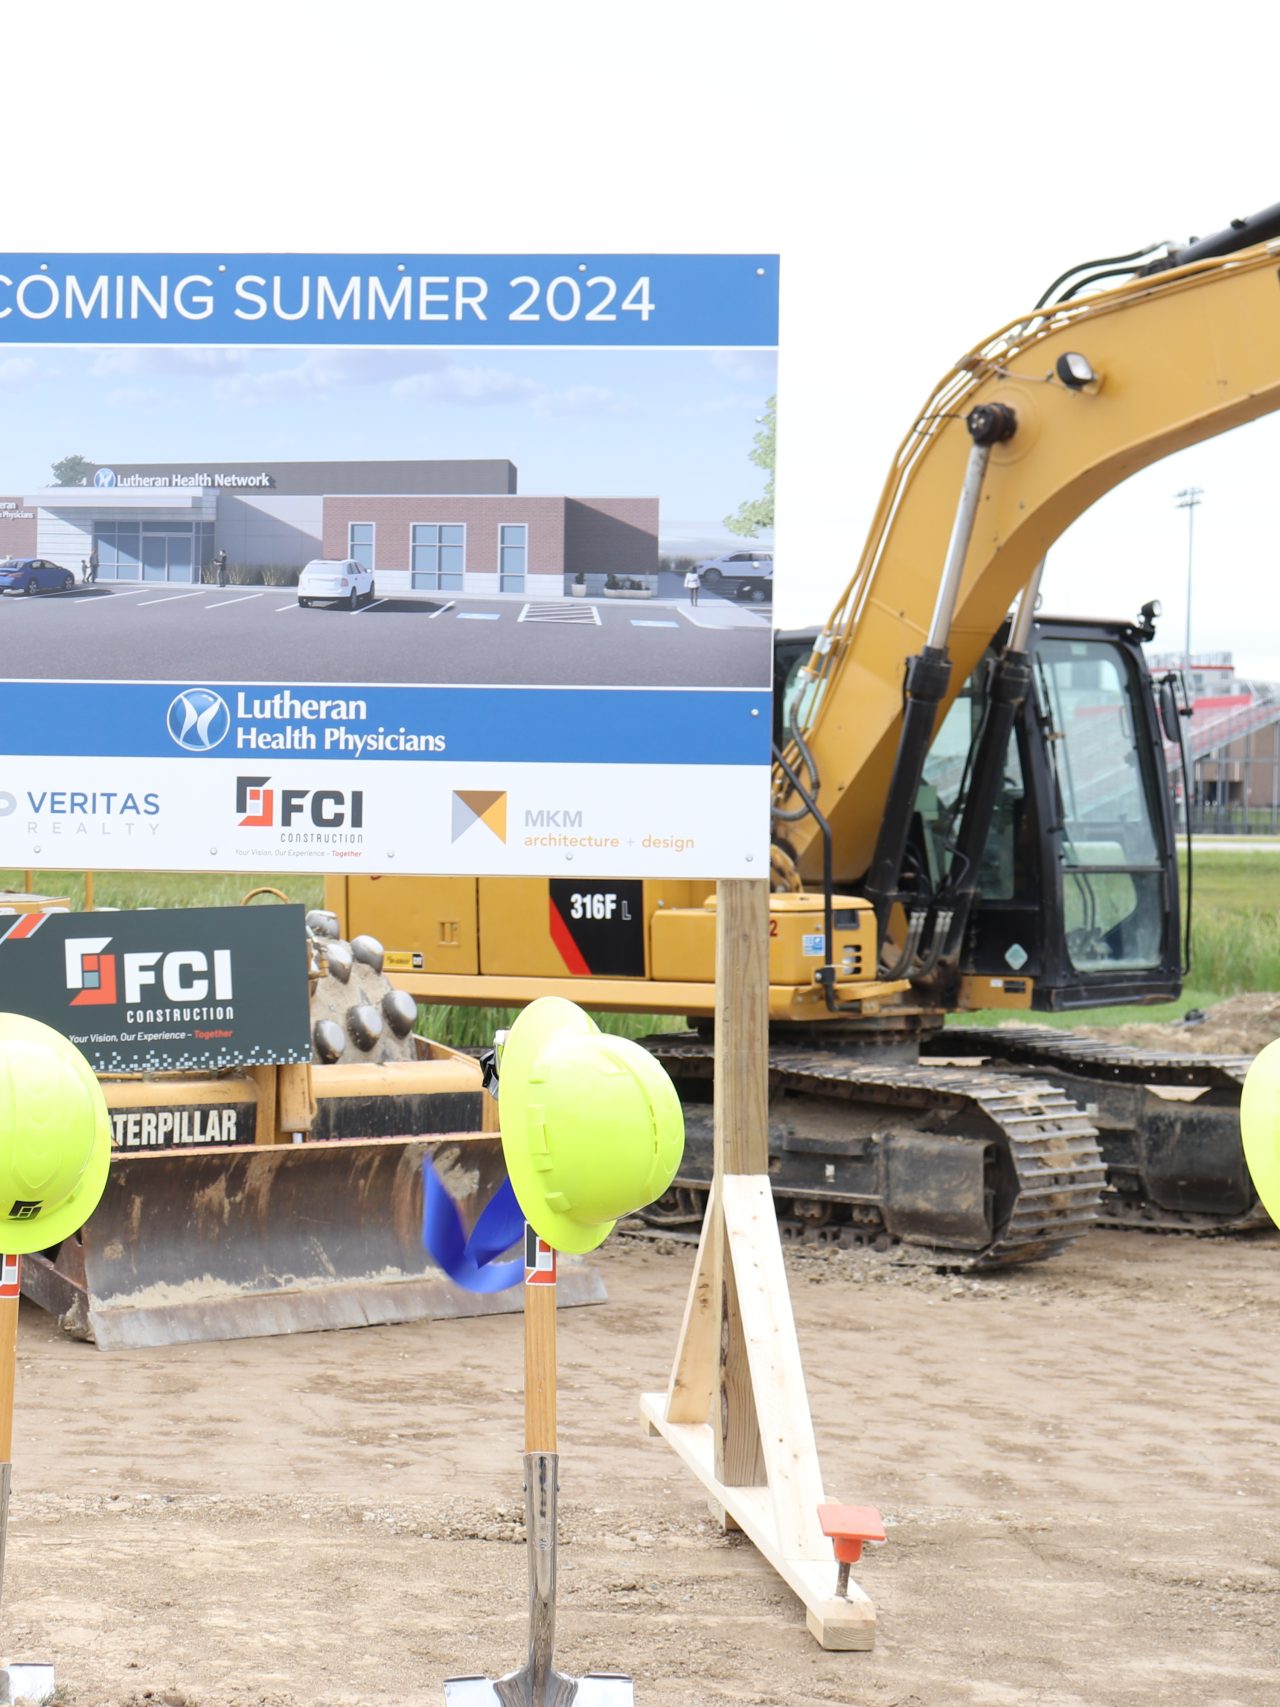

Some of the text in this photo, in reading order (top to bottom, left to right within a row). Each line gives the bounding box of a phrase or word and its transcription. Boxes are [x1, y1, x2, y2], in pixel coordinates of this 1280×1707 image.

[233, 275, 489, 321] SUMMER
[508, 276, 656, 321] 2024
[117, 473, 270, 487] Lutheran Health Network
[236, 690, 368, 720] Lutheran
[236, 726, 446, 758] Health Physicians
[27, 792, 160, 815] VERITAS
[281, 789, 363, 828] FCI
[27, 821, 160, 836] REALTY
[524, 810, 583, 828] MKM
[280, 833, 363, 843] CONSTRUCTION
[524, 833, 620, 848] architecture
[641, 834, 695, 852] design
[235, 849, 250, 857] Your
[274, 849, 287, 857] Our
[287, 850, 325, 858] Experience
[332, 850, 362, 858] Together
[570, 893, 632, 920] 316F L
[123, 949, 233, 1004] FCI
[126, 1006, 234, 1024] CONSTRUCTION
[69, 1034, 88, 1044] Your
[120, 1032, 135, 1041] Our
[137, 1030, 186, 1043] Experience
[194, 1029, 233, 1040] Together
[109, 1109, 237, 1146] TERPILLAR
